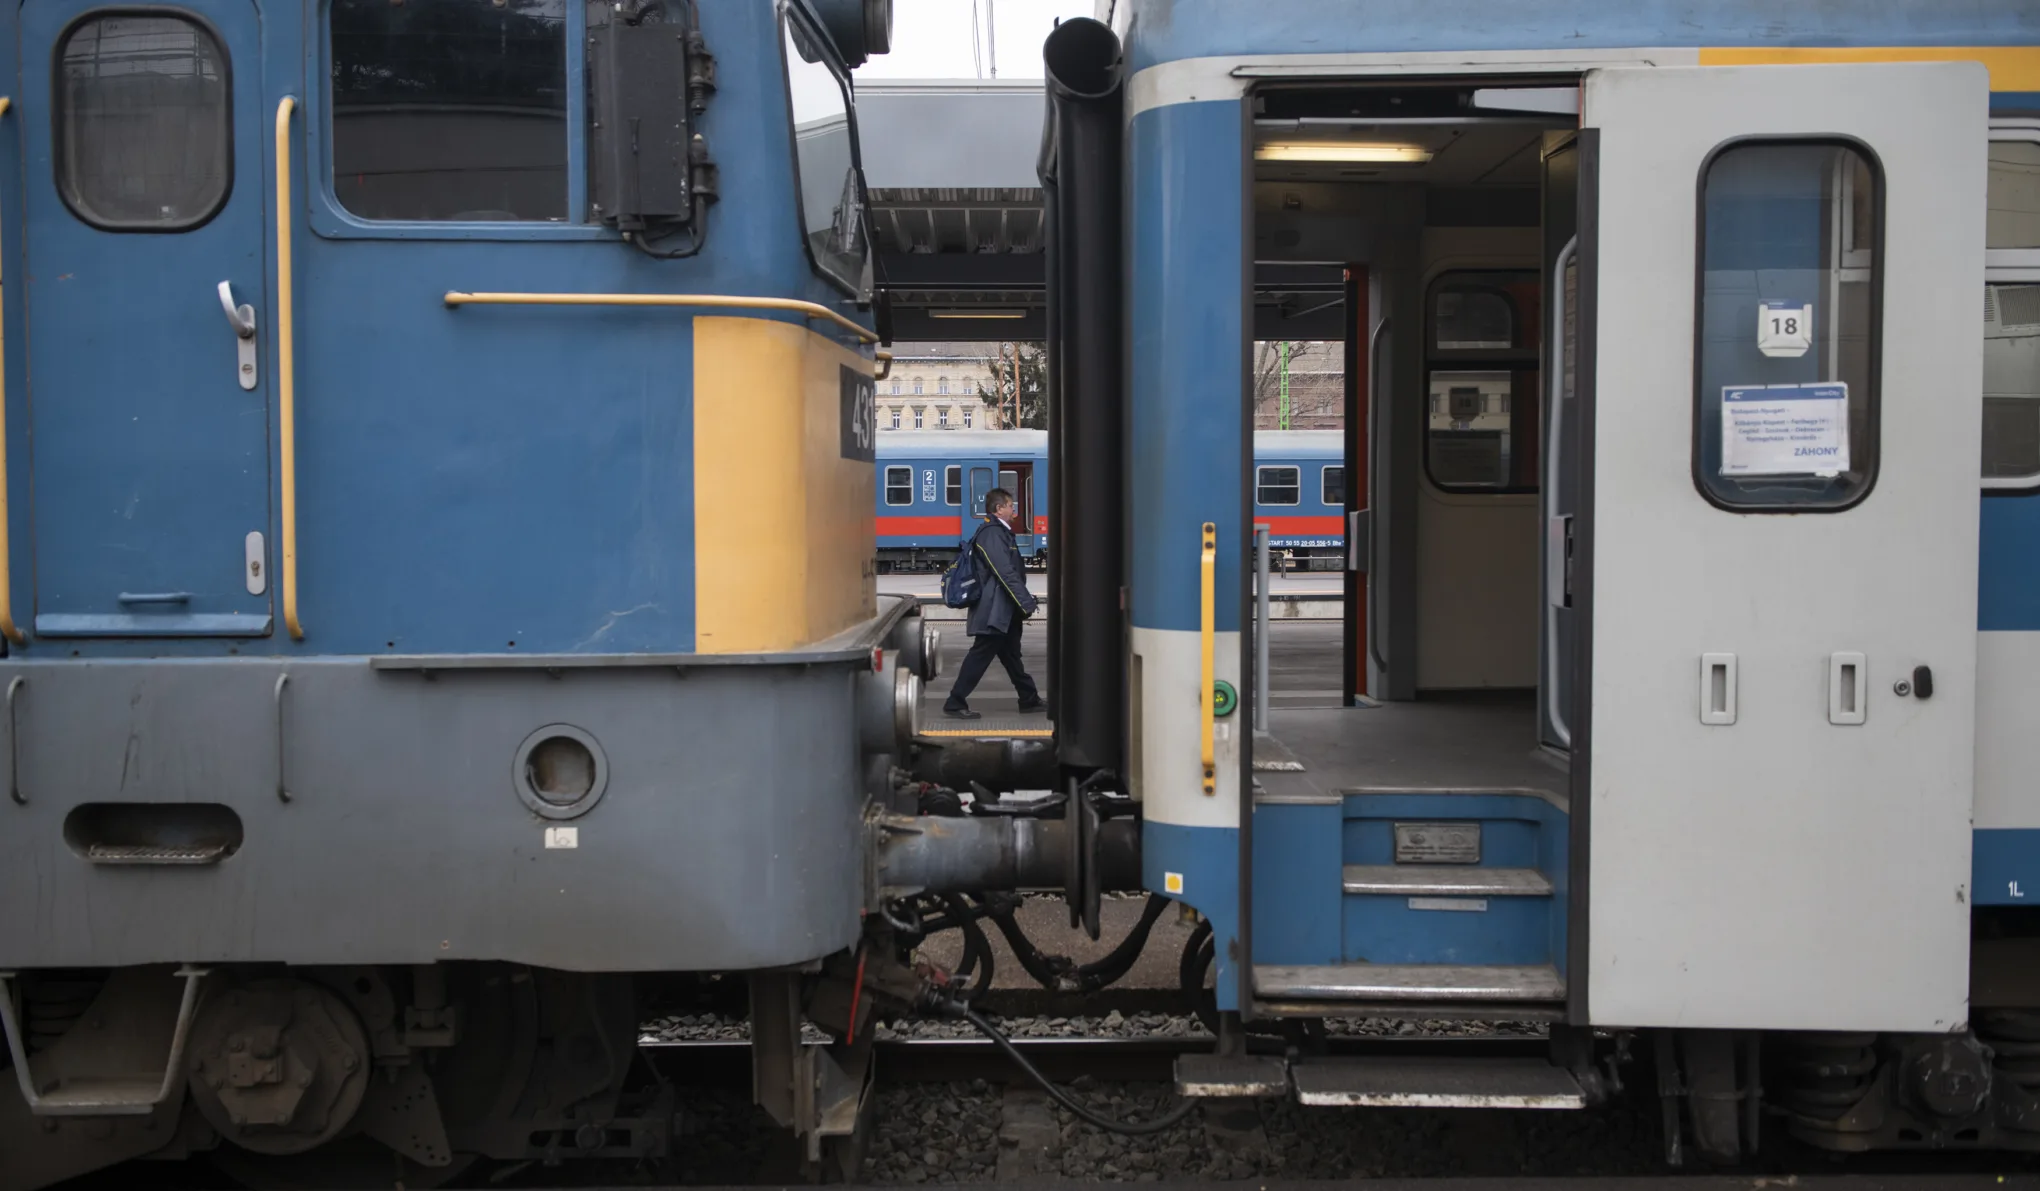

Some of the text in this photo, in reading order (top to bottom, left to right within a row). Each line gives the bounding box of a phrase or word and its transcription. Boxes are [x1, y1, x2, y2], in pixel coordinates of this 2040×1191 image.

[1771, 317, 1798, 335] 18
[925, 471, 933, 481] 2
[2008, 880, 2024, 897] 1L
